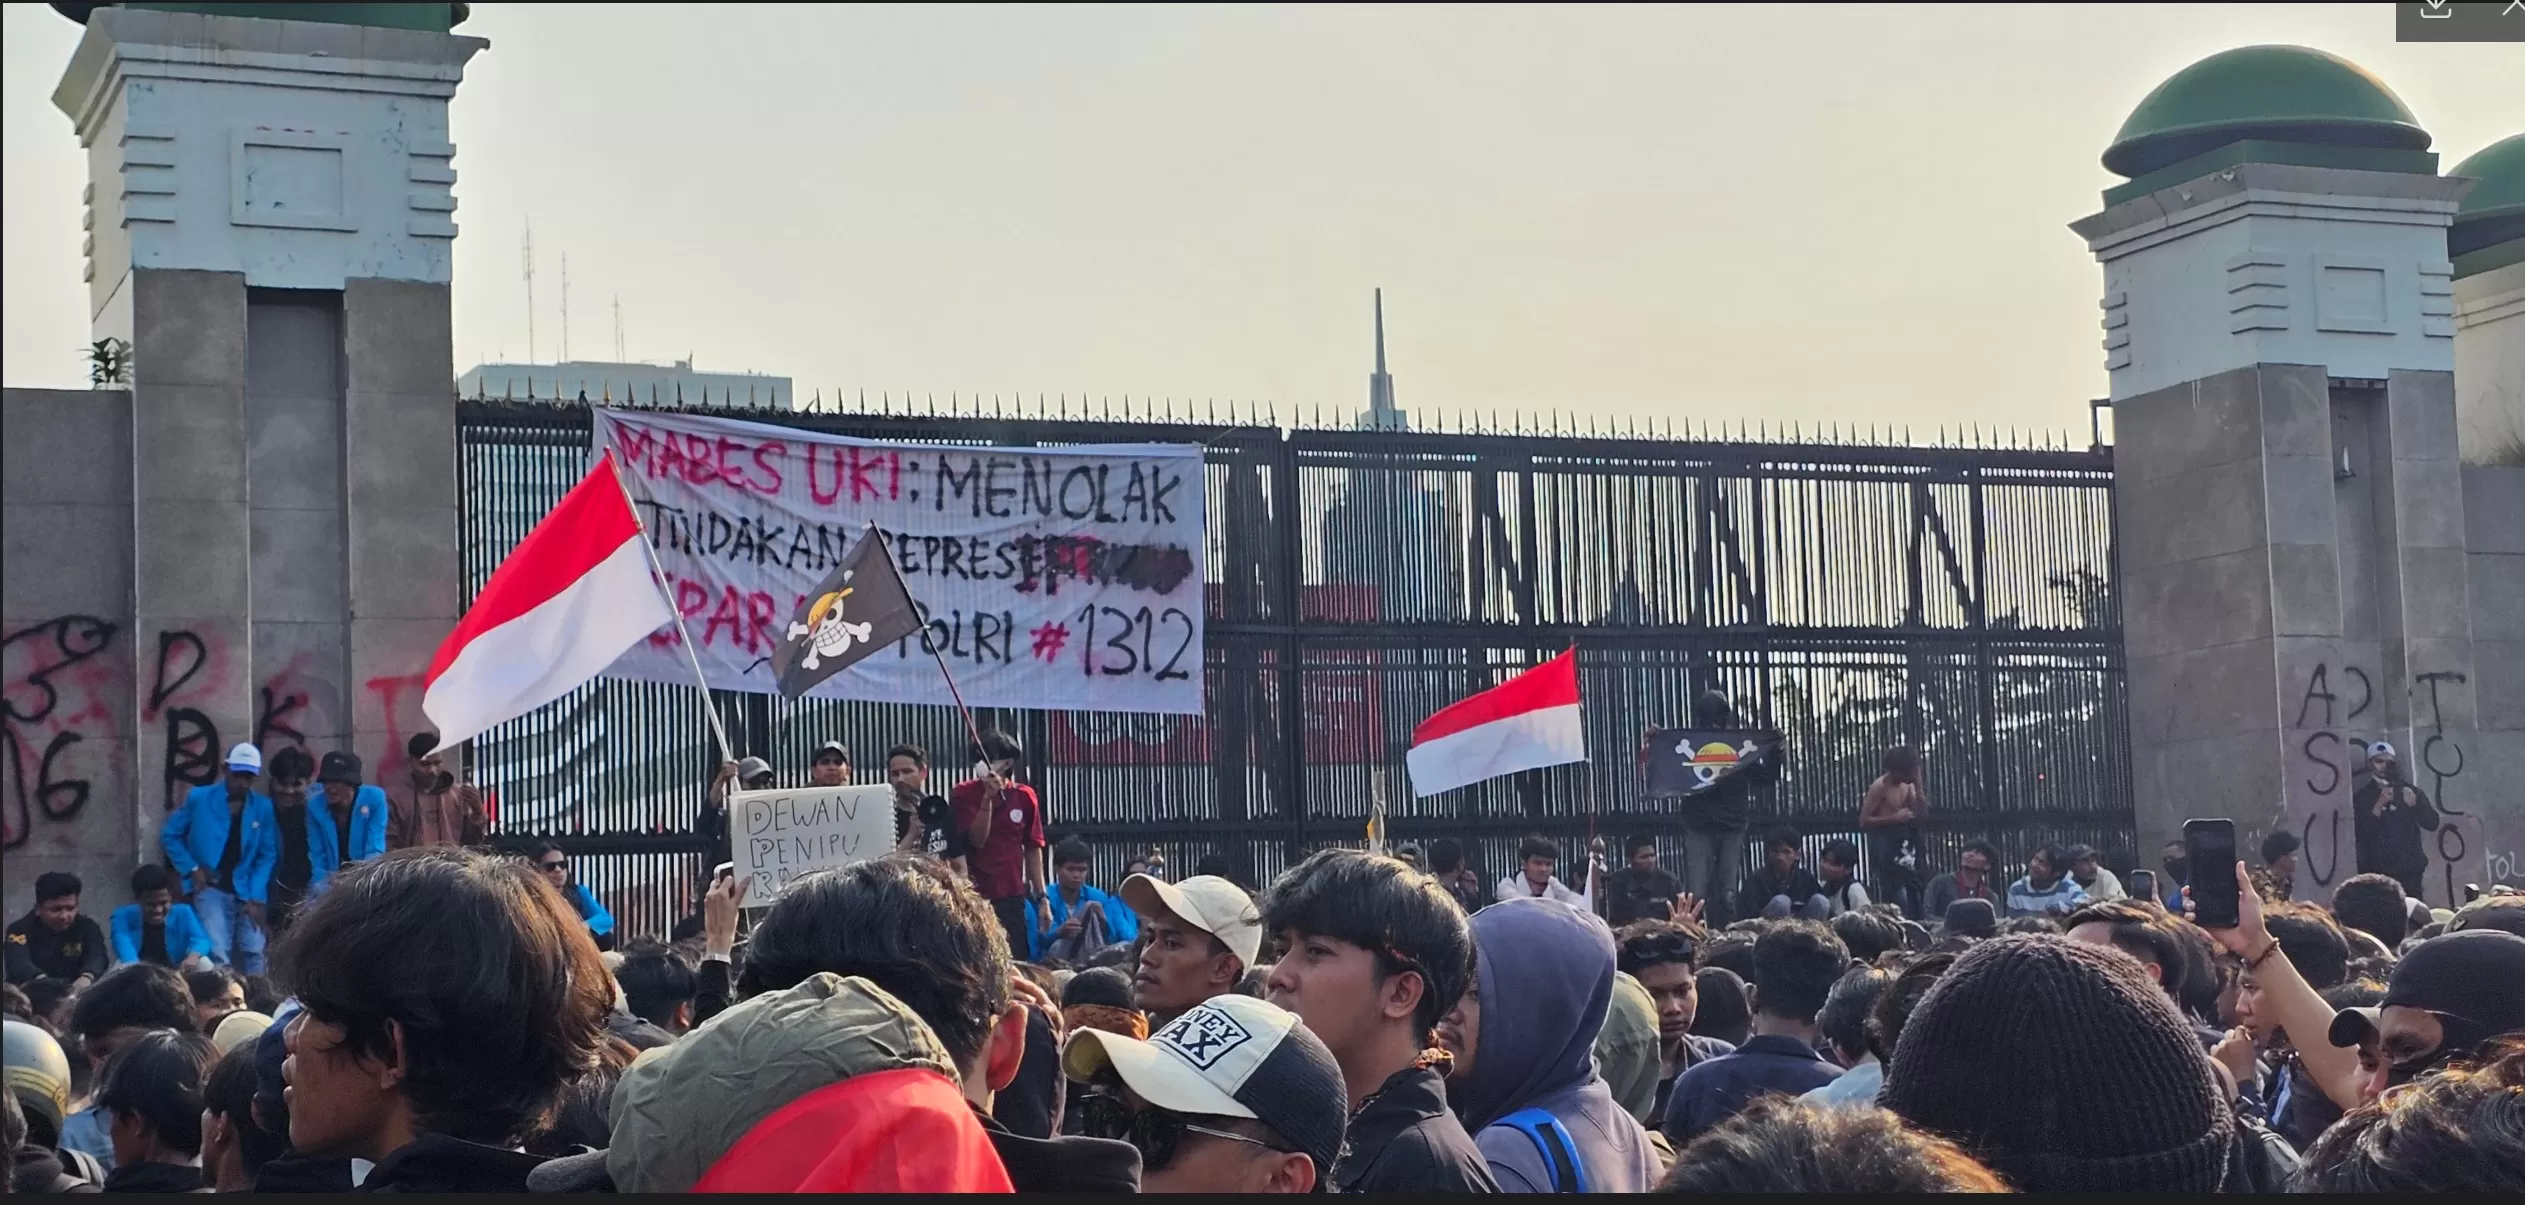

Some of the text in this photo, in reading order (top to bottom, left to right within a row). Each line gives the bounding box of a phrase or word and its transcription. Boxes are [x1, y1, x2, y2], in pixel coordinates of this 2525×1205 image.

[615, 420, 787, 494] MABES
[936, 453, 1181, 525] MENOLAK
[745, 795, 860, 836] DEWAN
[750, 833, 860, 869] PENIPU
[1178, 1009, 1241, 1044] NEY
